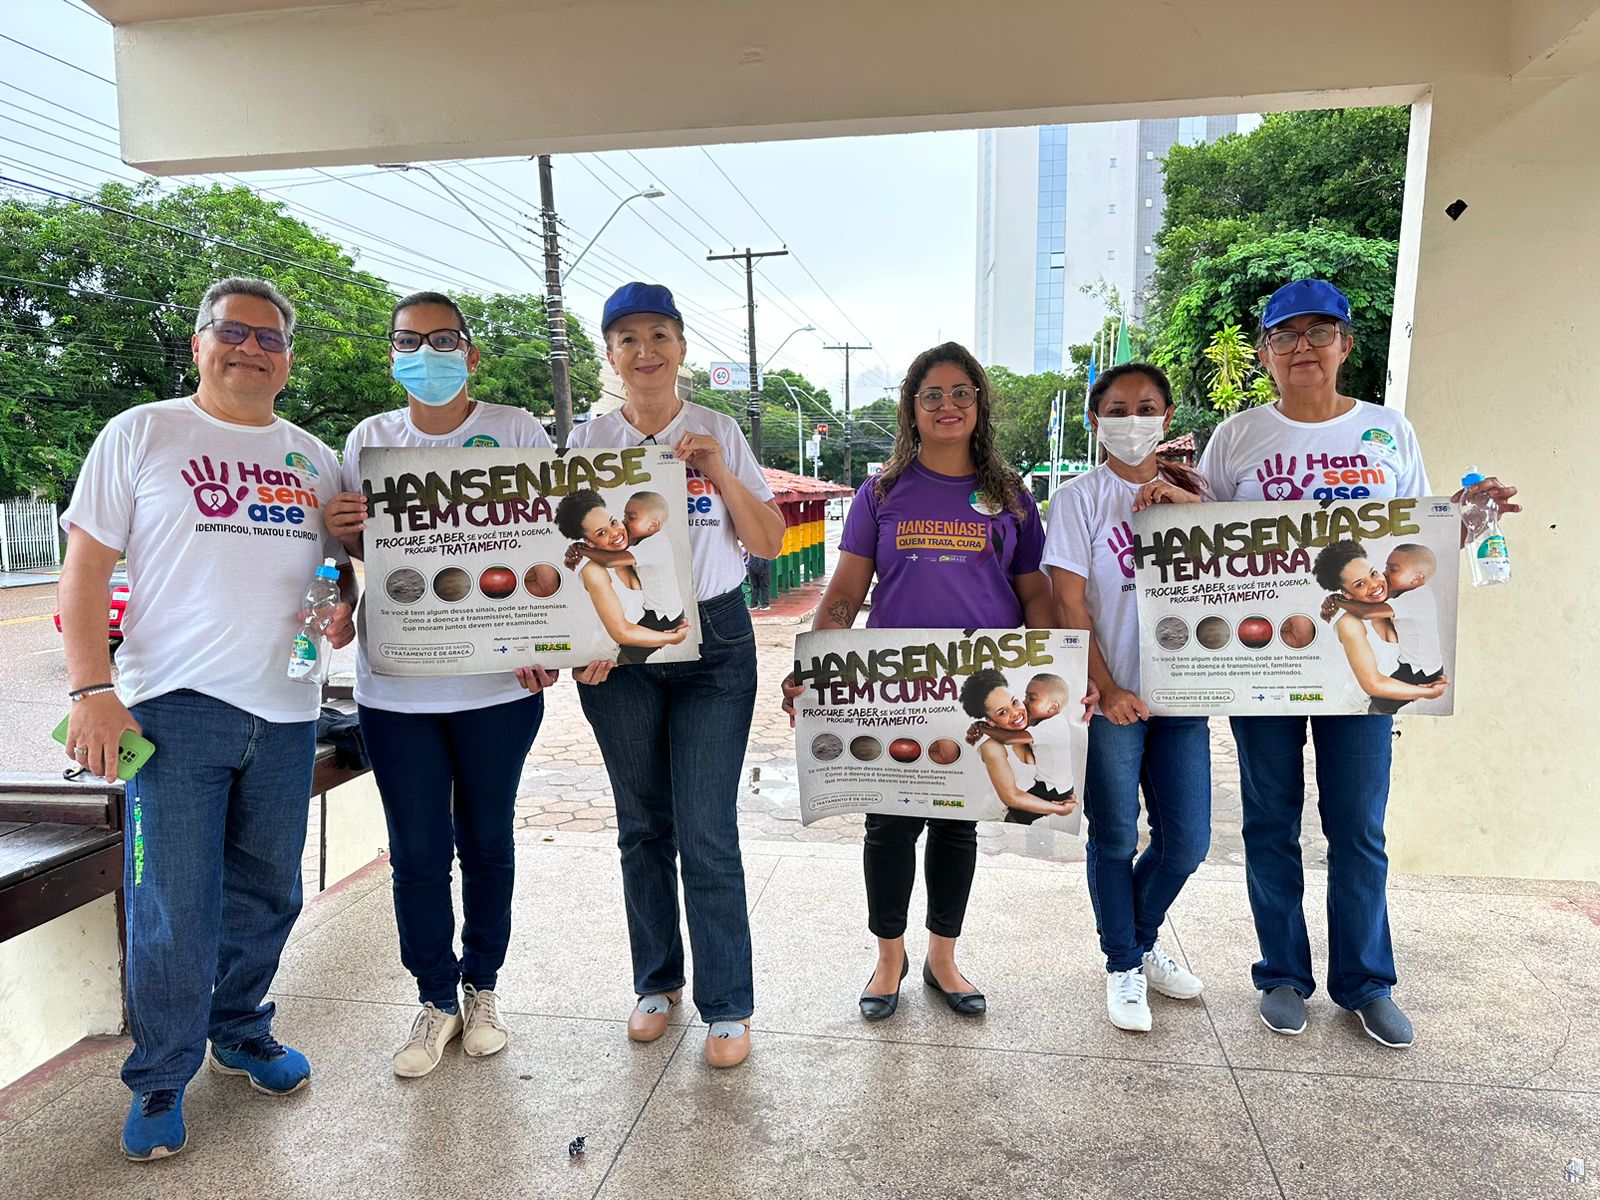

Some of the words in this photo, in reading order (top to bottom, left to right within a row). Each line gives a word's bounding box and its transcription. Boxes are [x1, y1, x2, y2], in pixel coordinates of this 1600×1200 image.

[1306, 453, 1368, 469] Han
[237, 461, 302, 488] Han
[362, 447, 652, 518] HANSENÍASE
[1323, 463, 1385, 485] seni
[687, 479, 720, 495] en
[1313, 486, 1371, 500] ase
[257, 486, 319, 509] seni
[687, 496, 712, 514] se
[247, 503, 305, 525] ase
[383, 502, 460, 533] TEM
[465, 497, 553, 527] CURA
[195, 523, 252, 536] IDENTIFICOU,
[252, 527, 285, 537] TRATOU
[286, 529, 292, 537] E
[896, 518, 987, 537] HANSENÍASE
[1133, 497, 1420, 569] HANSENÍASE
[376, 535, 426, 549] PROCURE
[429, 532, 466, 545] SABER
[404, 545, 438, 555] PROCURE
[439, 538, 522, 556] TRATAMENTO.
[899, 537, 926, 547] QUEM
[956, 539, 982, 549] CURA
[1151, 554, 1221, 583] TEM
[1226, 548, 1311, 577] CURA
[1145, 585, 1189, 599] PROCURE
[1191, 582, 1226, 594] SABER
[1170, 595, 1200, 604] PROCURE
[1201, 589, 1279, 606] TRATAMENTO.
[432, 616, 459, 624] doença
[534, 643, 572, 652] BRASIL
[794, 629, 1053, 687] HANSENÍASE
[810, 681, 875, 705] TEM
[880, 675, 958, 703] CURA
[803, 708, 844, 718] PROCURE
[848, 707, 880, 717] SABER
[826, 716, 854, 724] PROCURE
[856, 715, 928, 728] TRATAMENTO.
[932, 800, 964, 808] BRASIL
